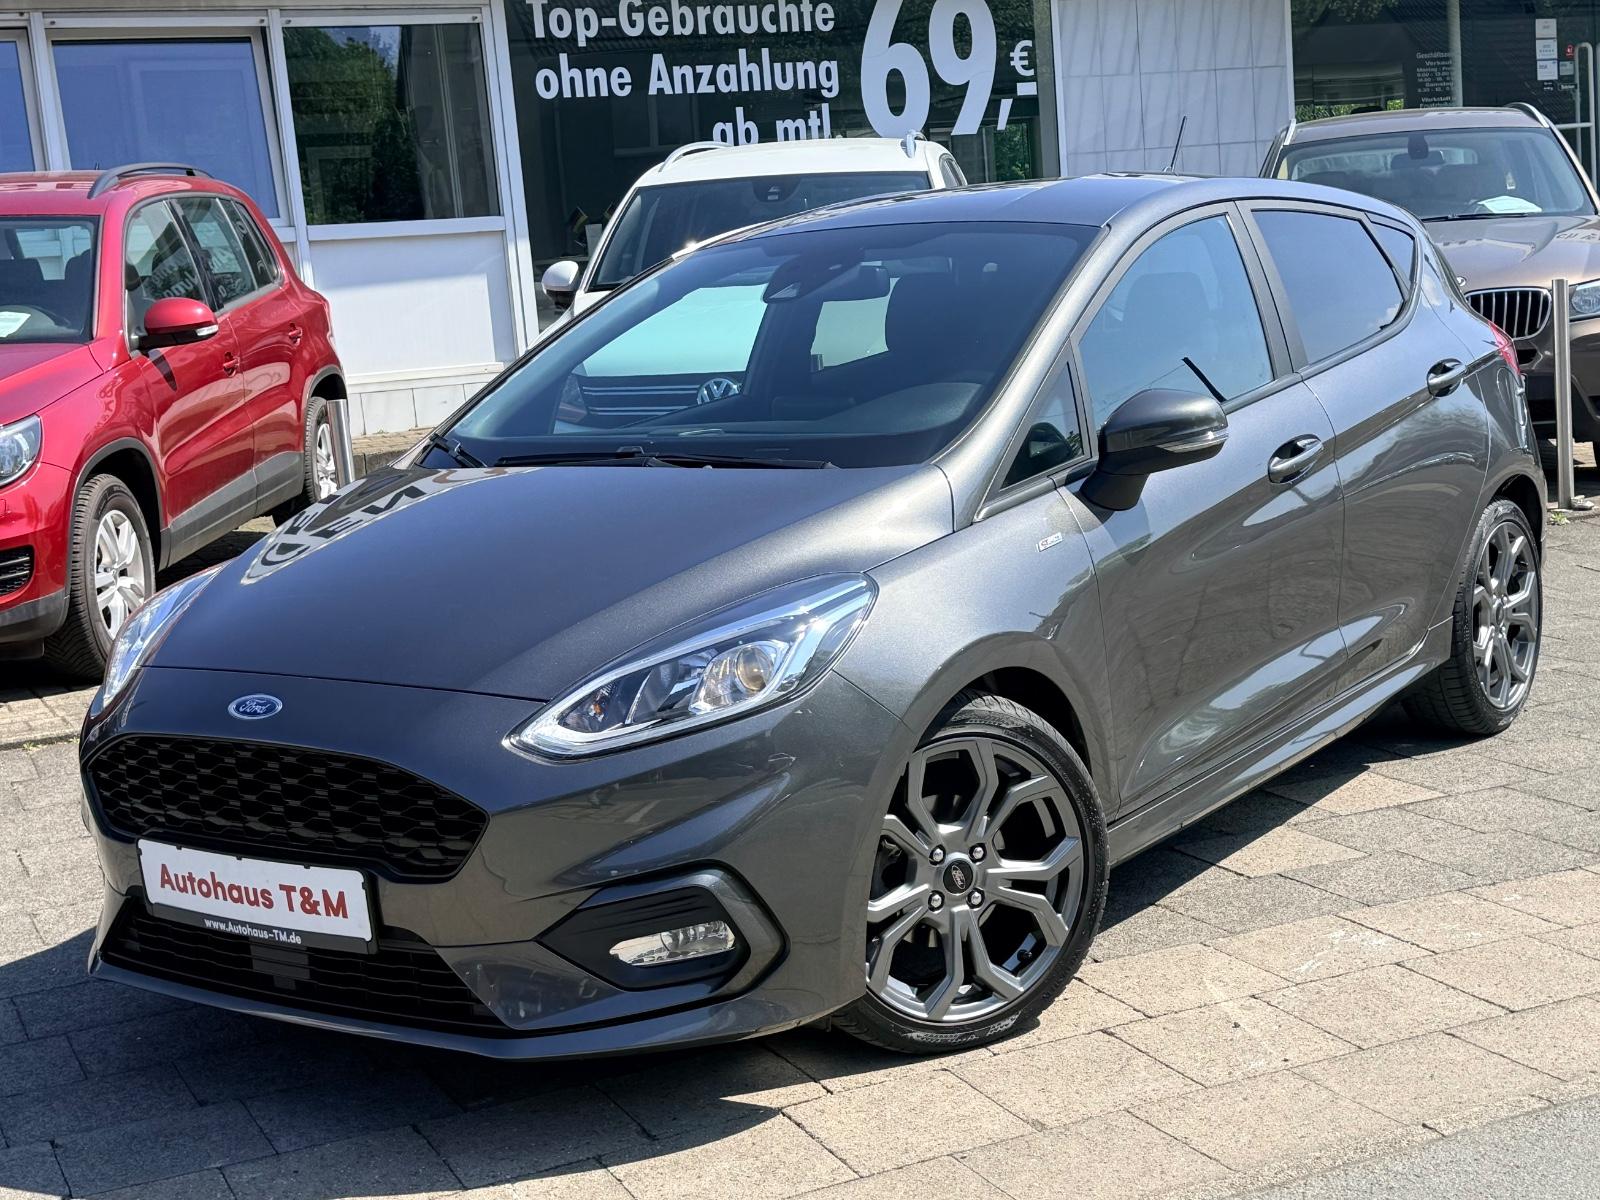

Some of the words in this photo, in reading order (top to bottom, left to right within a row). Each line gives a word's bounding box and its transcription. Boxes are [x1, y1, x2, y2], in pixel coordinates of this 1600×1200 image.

[526, 0, 835, 47] Top-Gebrauchte
[535, 52, 633, 99] ohne
[648, 47, 840, 98] Anzahlung
[712, 106, 759, 146] ab
[160, 864, 273, 909] Autohaus
[279, 884, 349, 919] T&M
[204, 918, 302, 945] www.Autohaus-TM.de
